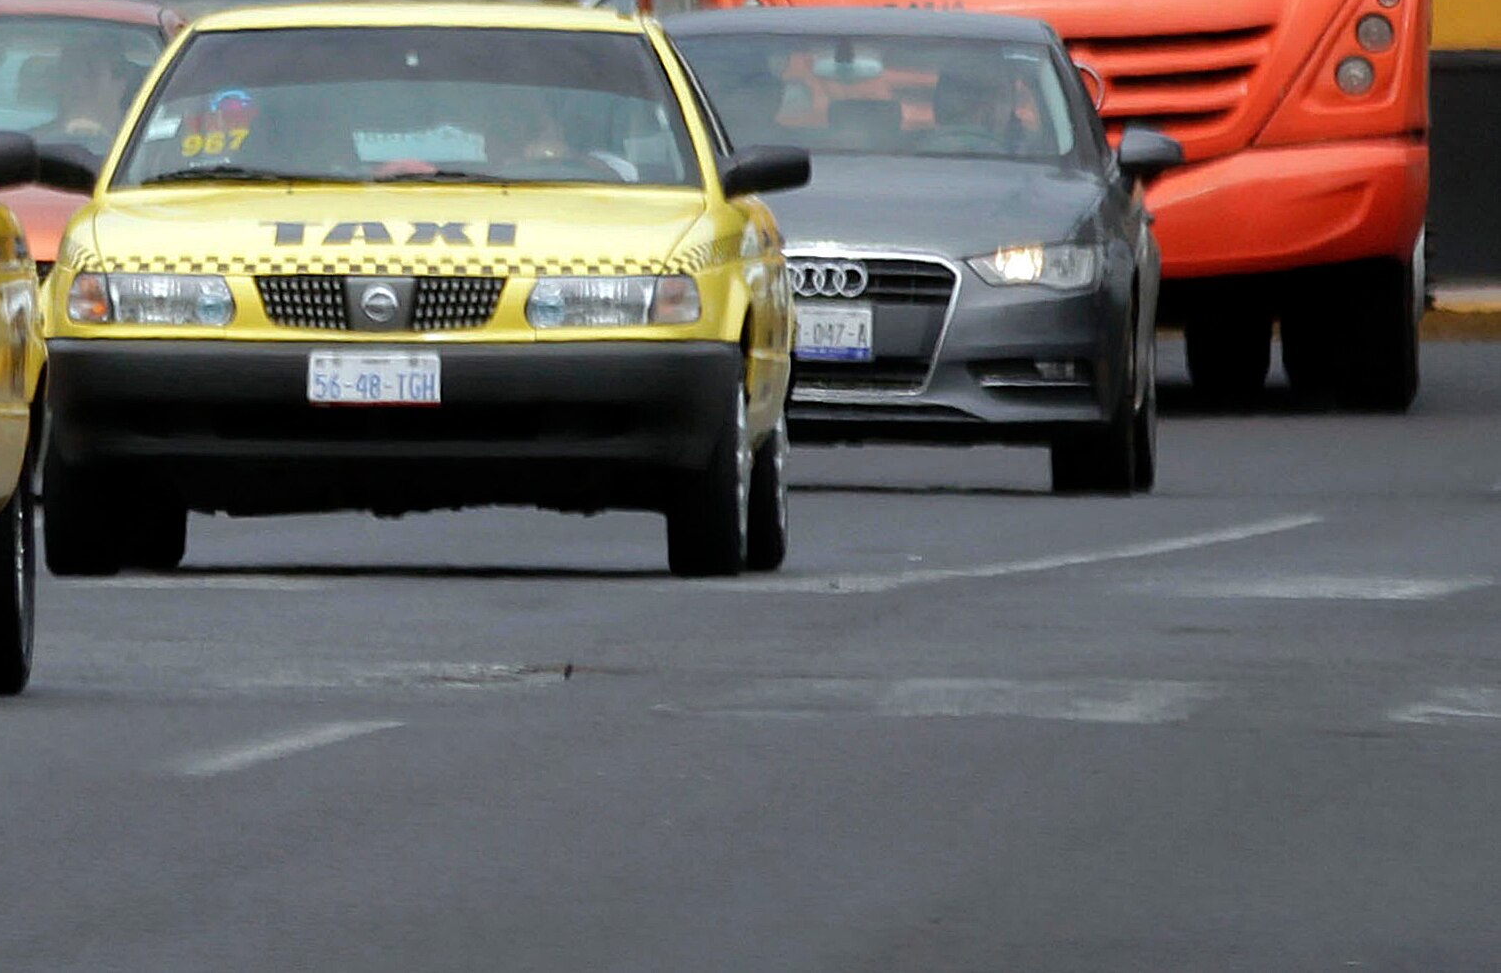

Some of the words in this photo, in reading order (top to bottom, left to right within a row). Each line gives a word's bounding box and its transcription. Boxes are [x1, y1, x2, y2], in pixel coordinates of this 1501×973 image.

[181, 128, 250, 158] 967
[258, 221, 518, 247] TAXI
[314, 372, 436, 400] 56-48-TGH
